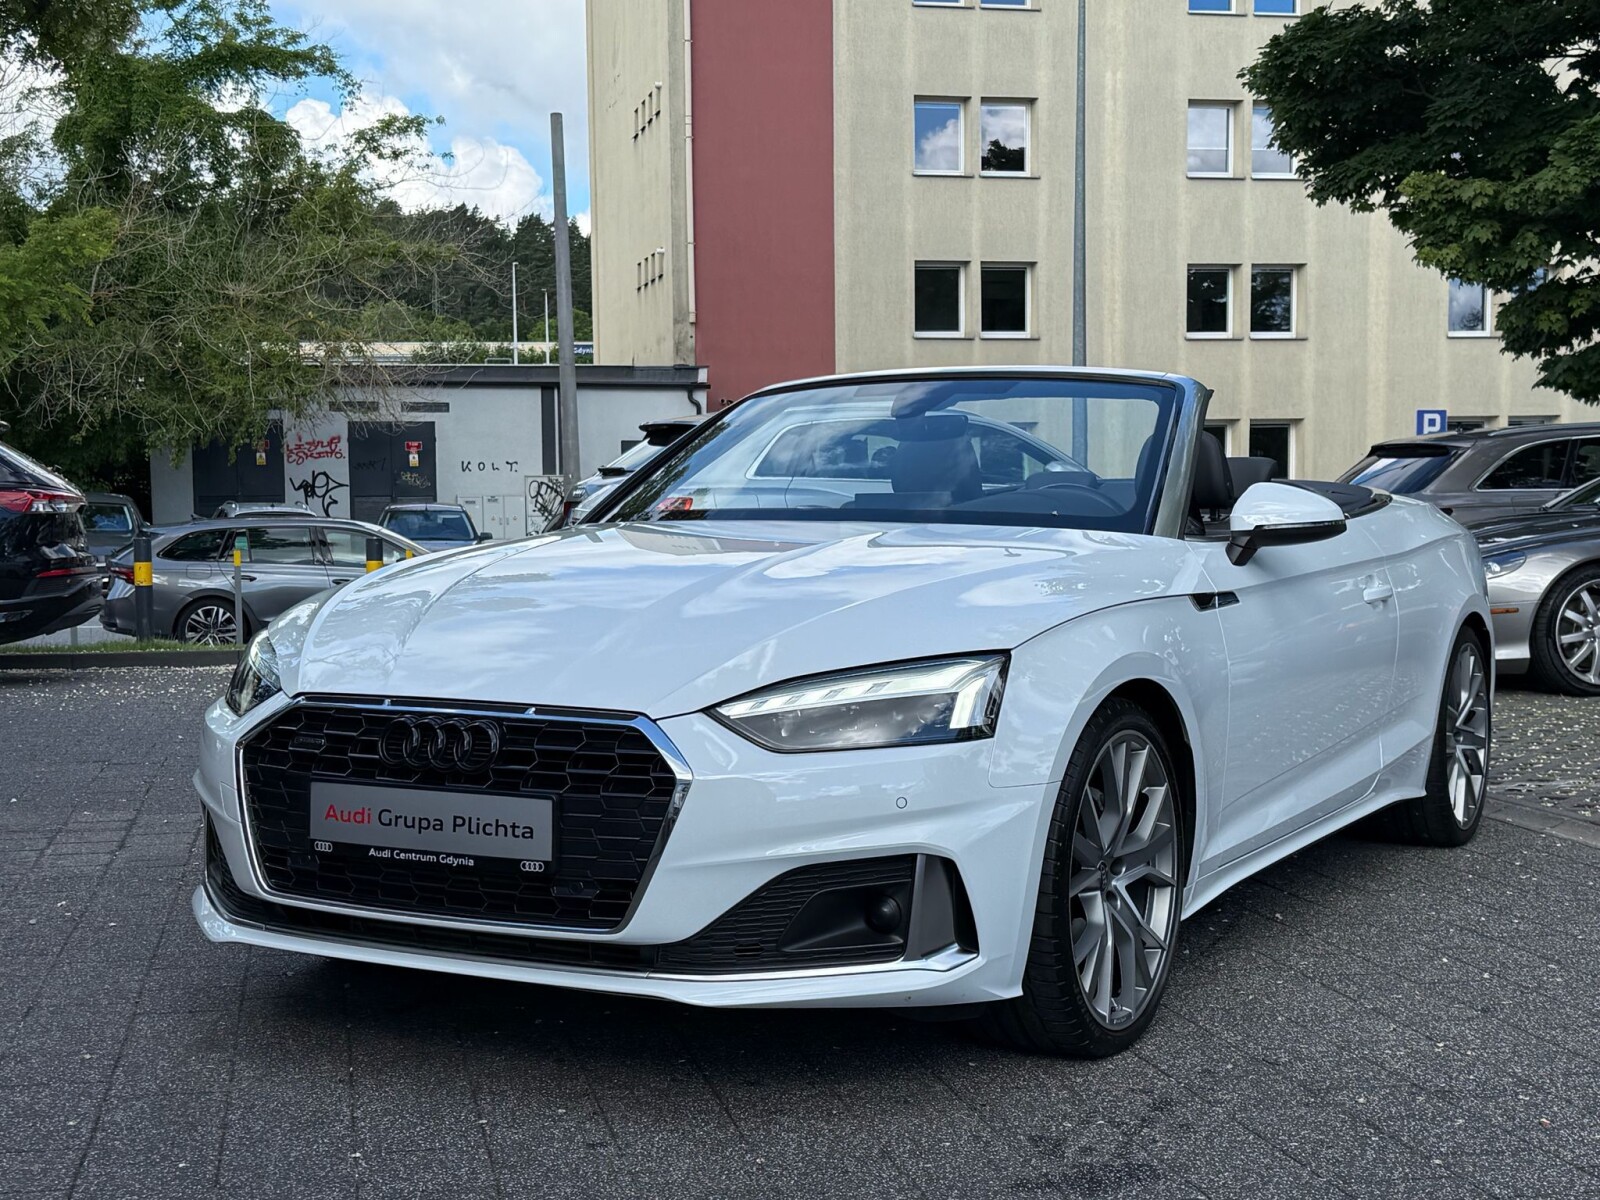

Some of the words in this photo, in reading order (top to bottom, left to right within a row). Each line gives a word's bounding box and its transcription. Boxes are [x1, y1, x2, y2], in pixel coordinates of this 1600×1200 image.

[1423, 413, 1441, 434] P
[324, 804, 372, 825] Audi
[377, 808, 444, 834] Grupa
[452, 815, 534, 840] Plichta
[368, 847, 391, 858] Audi
[393, 850, 437, 863] Centrum
[439, 854, 475, 867] Gdynia
